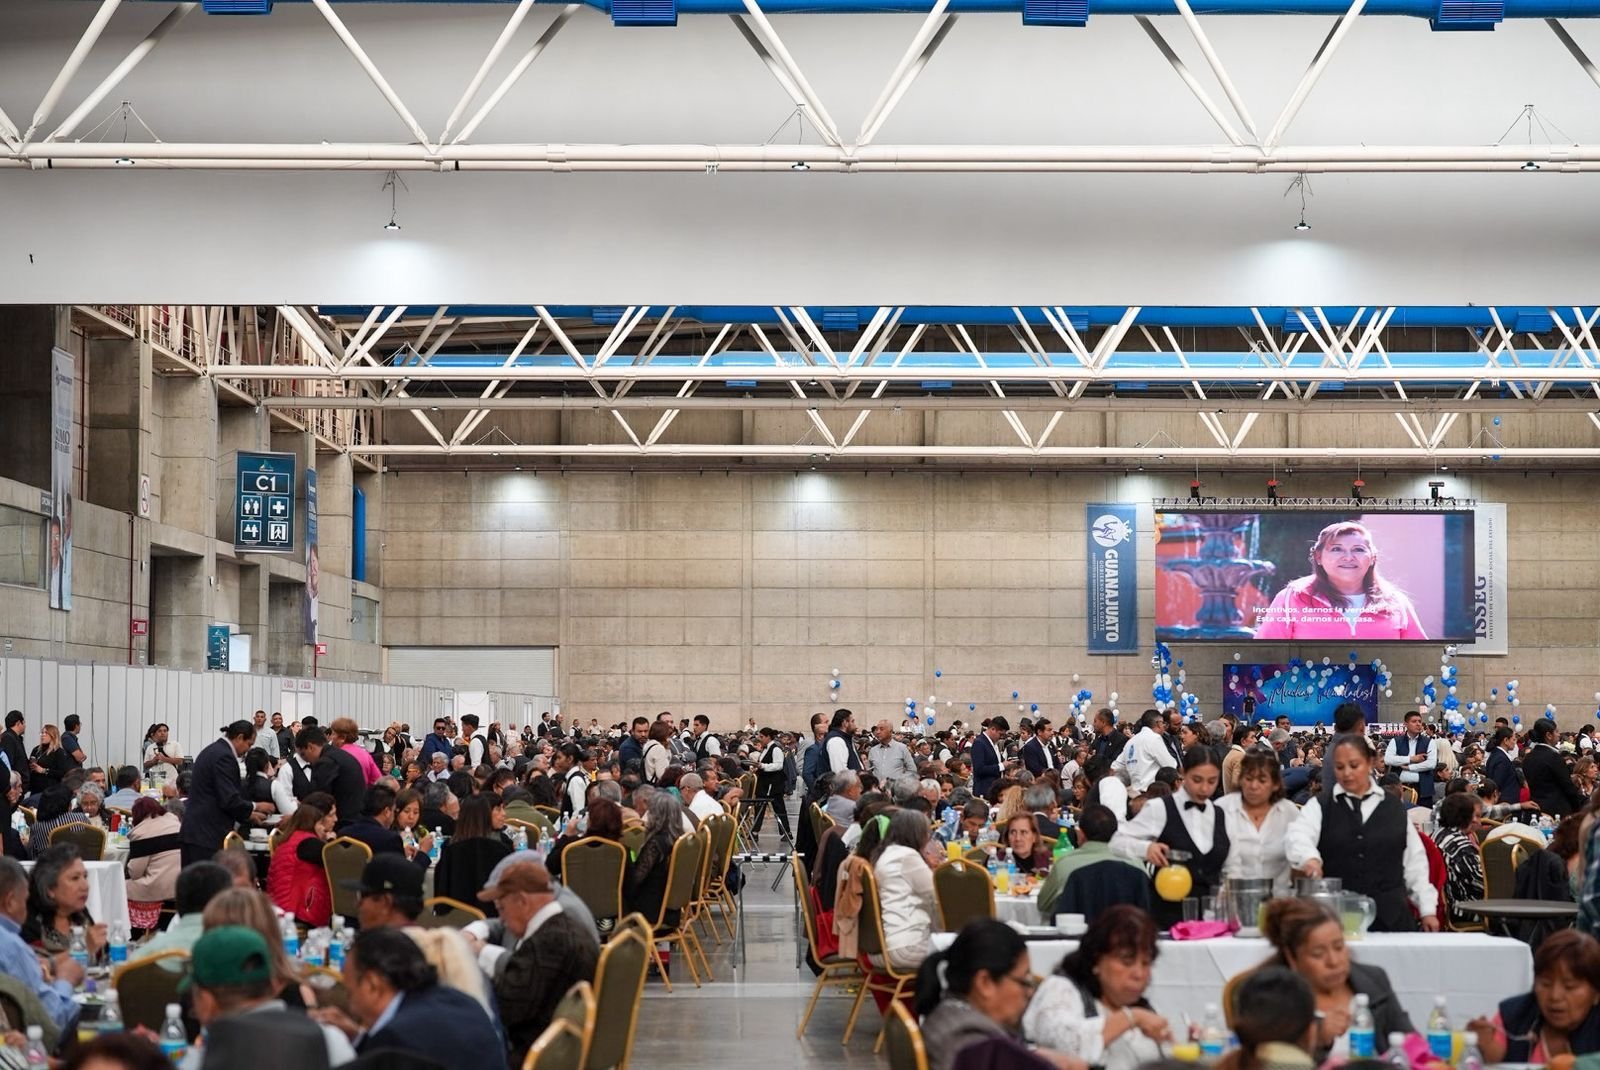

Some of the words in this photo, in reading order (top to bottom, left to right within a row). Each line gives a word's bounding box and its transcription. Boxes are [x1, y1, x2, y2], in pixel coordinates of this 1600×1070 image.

[256, 475, 276, 491] C1
[1099, 593, 1105, 601] DE
[1105, 549, 1119, 642] GUANAJUATO
[1099, 602, 1105, 610] LA
[1474, 576, 1487, 639] ISSEG
